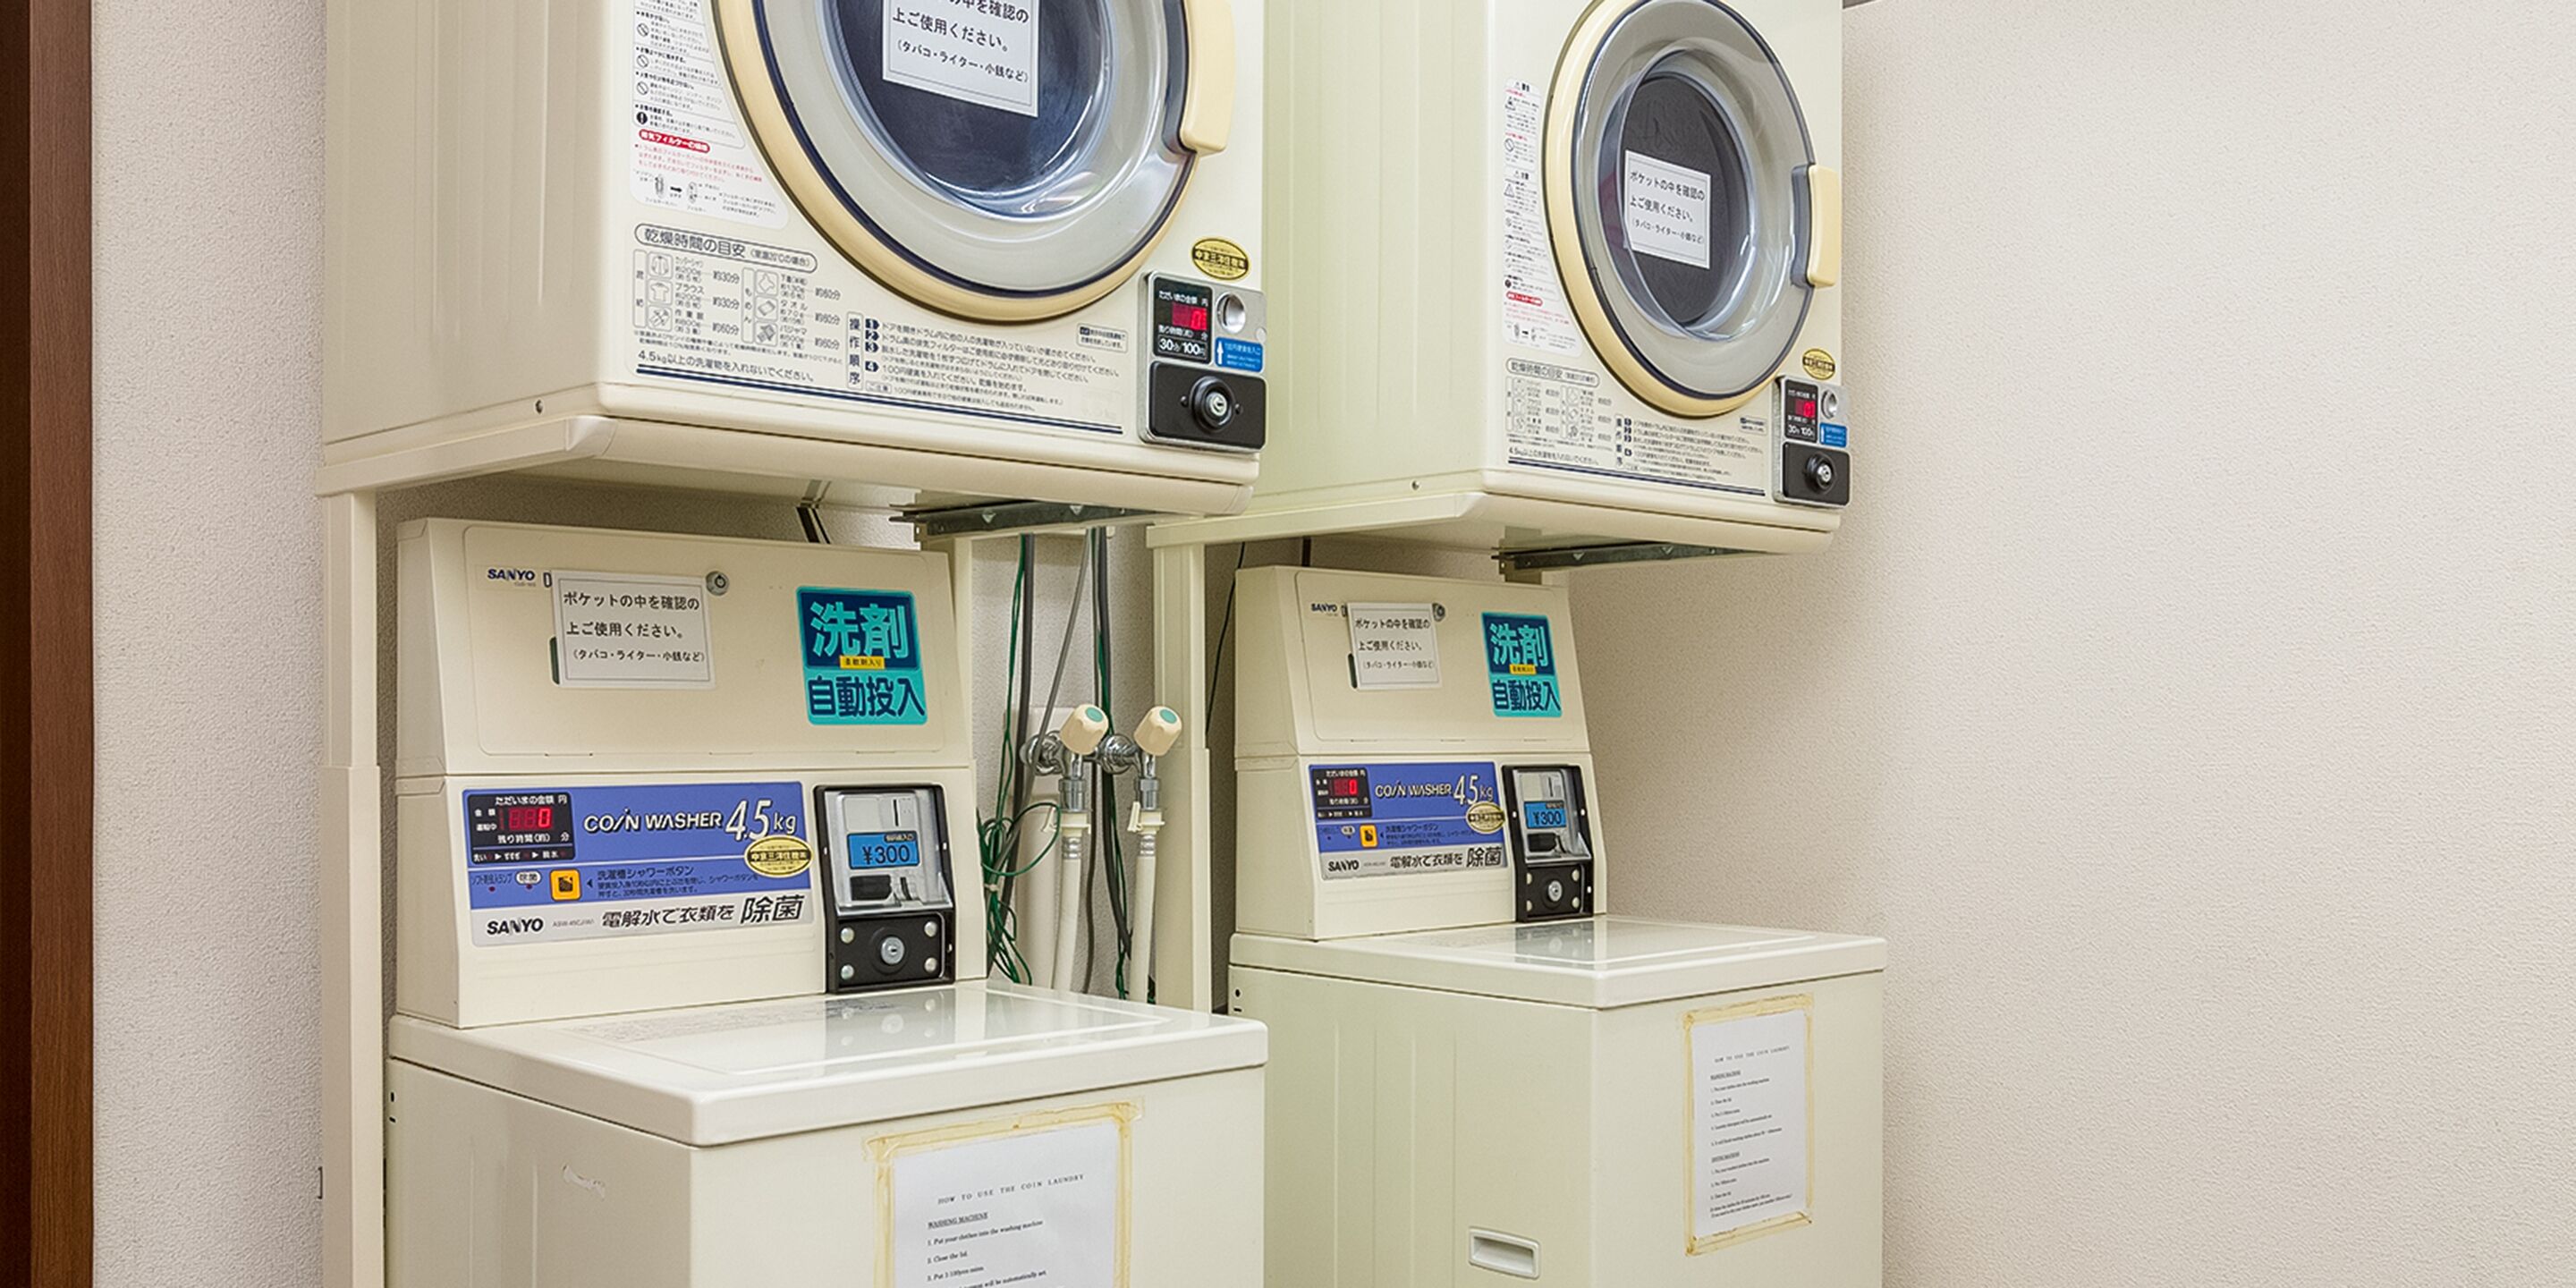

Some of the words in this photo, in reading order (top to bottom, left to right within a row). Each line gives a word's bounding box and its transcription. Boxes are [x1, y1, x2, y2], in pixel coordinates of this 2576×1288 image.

[893, 7, 1008, 52] 上ご使用ください。
[1630, 171, 1706, 201] ポケットの中を確認の
[1630, 195, 1693, 222] 上ご使用ください。
[644, 228, 745, 258] 乾燥時間の目安
[487, 569, 535, 581] SANYO
[563, 590, 700, 612] ポケットの中を確認の
[1310, 604, 1337, 613] SANYO
[566, 621, 683, 640] 上ご使用ください。
[809, 601, 909, 658] 洗剤
[1355, 618, 1431, 629] ポケットの中を確認の
[1359, 640, 1422, 651] 上ご使用ください。
[1489, 623, 1548, 667] 洗剤
[808, 674, 926, 717] 自動投入
[1492, 680, 1561, 711] 自動投入
[496, 795, 555, 805] ただいまの金額
[558, 794, 567, 804] 円
[1409, 784, 1452, 796] WASHER
[538, 808, 551, 828] 0
[646, 812, 724, 831] WASHER
[560, 831, 570, 842] 分
[862, 844, 911, 865] ¥300
[1467, 846, 1502, 868] 除菌
[597, 865, 694, 881] 洗濯槽シャワーボタン
[1328, 860, 1359, 872] SANYO
[602, 904, 735, 928] 電解水で衣類を
[741, 894, 805, 924] 除菌
[487, 919, 544, 935] SANYO
[937, 1197, 955, 1205] HOW
[961, 1193, 972, 1201] TO
[978, 1190, 994, 1199] USE
[1000, 1186, 1015, 1194] THE
[1021, 1181, 1042, 1191] COIN
[1047, 1174, 1084, 1186] LAUNDRY
